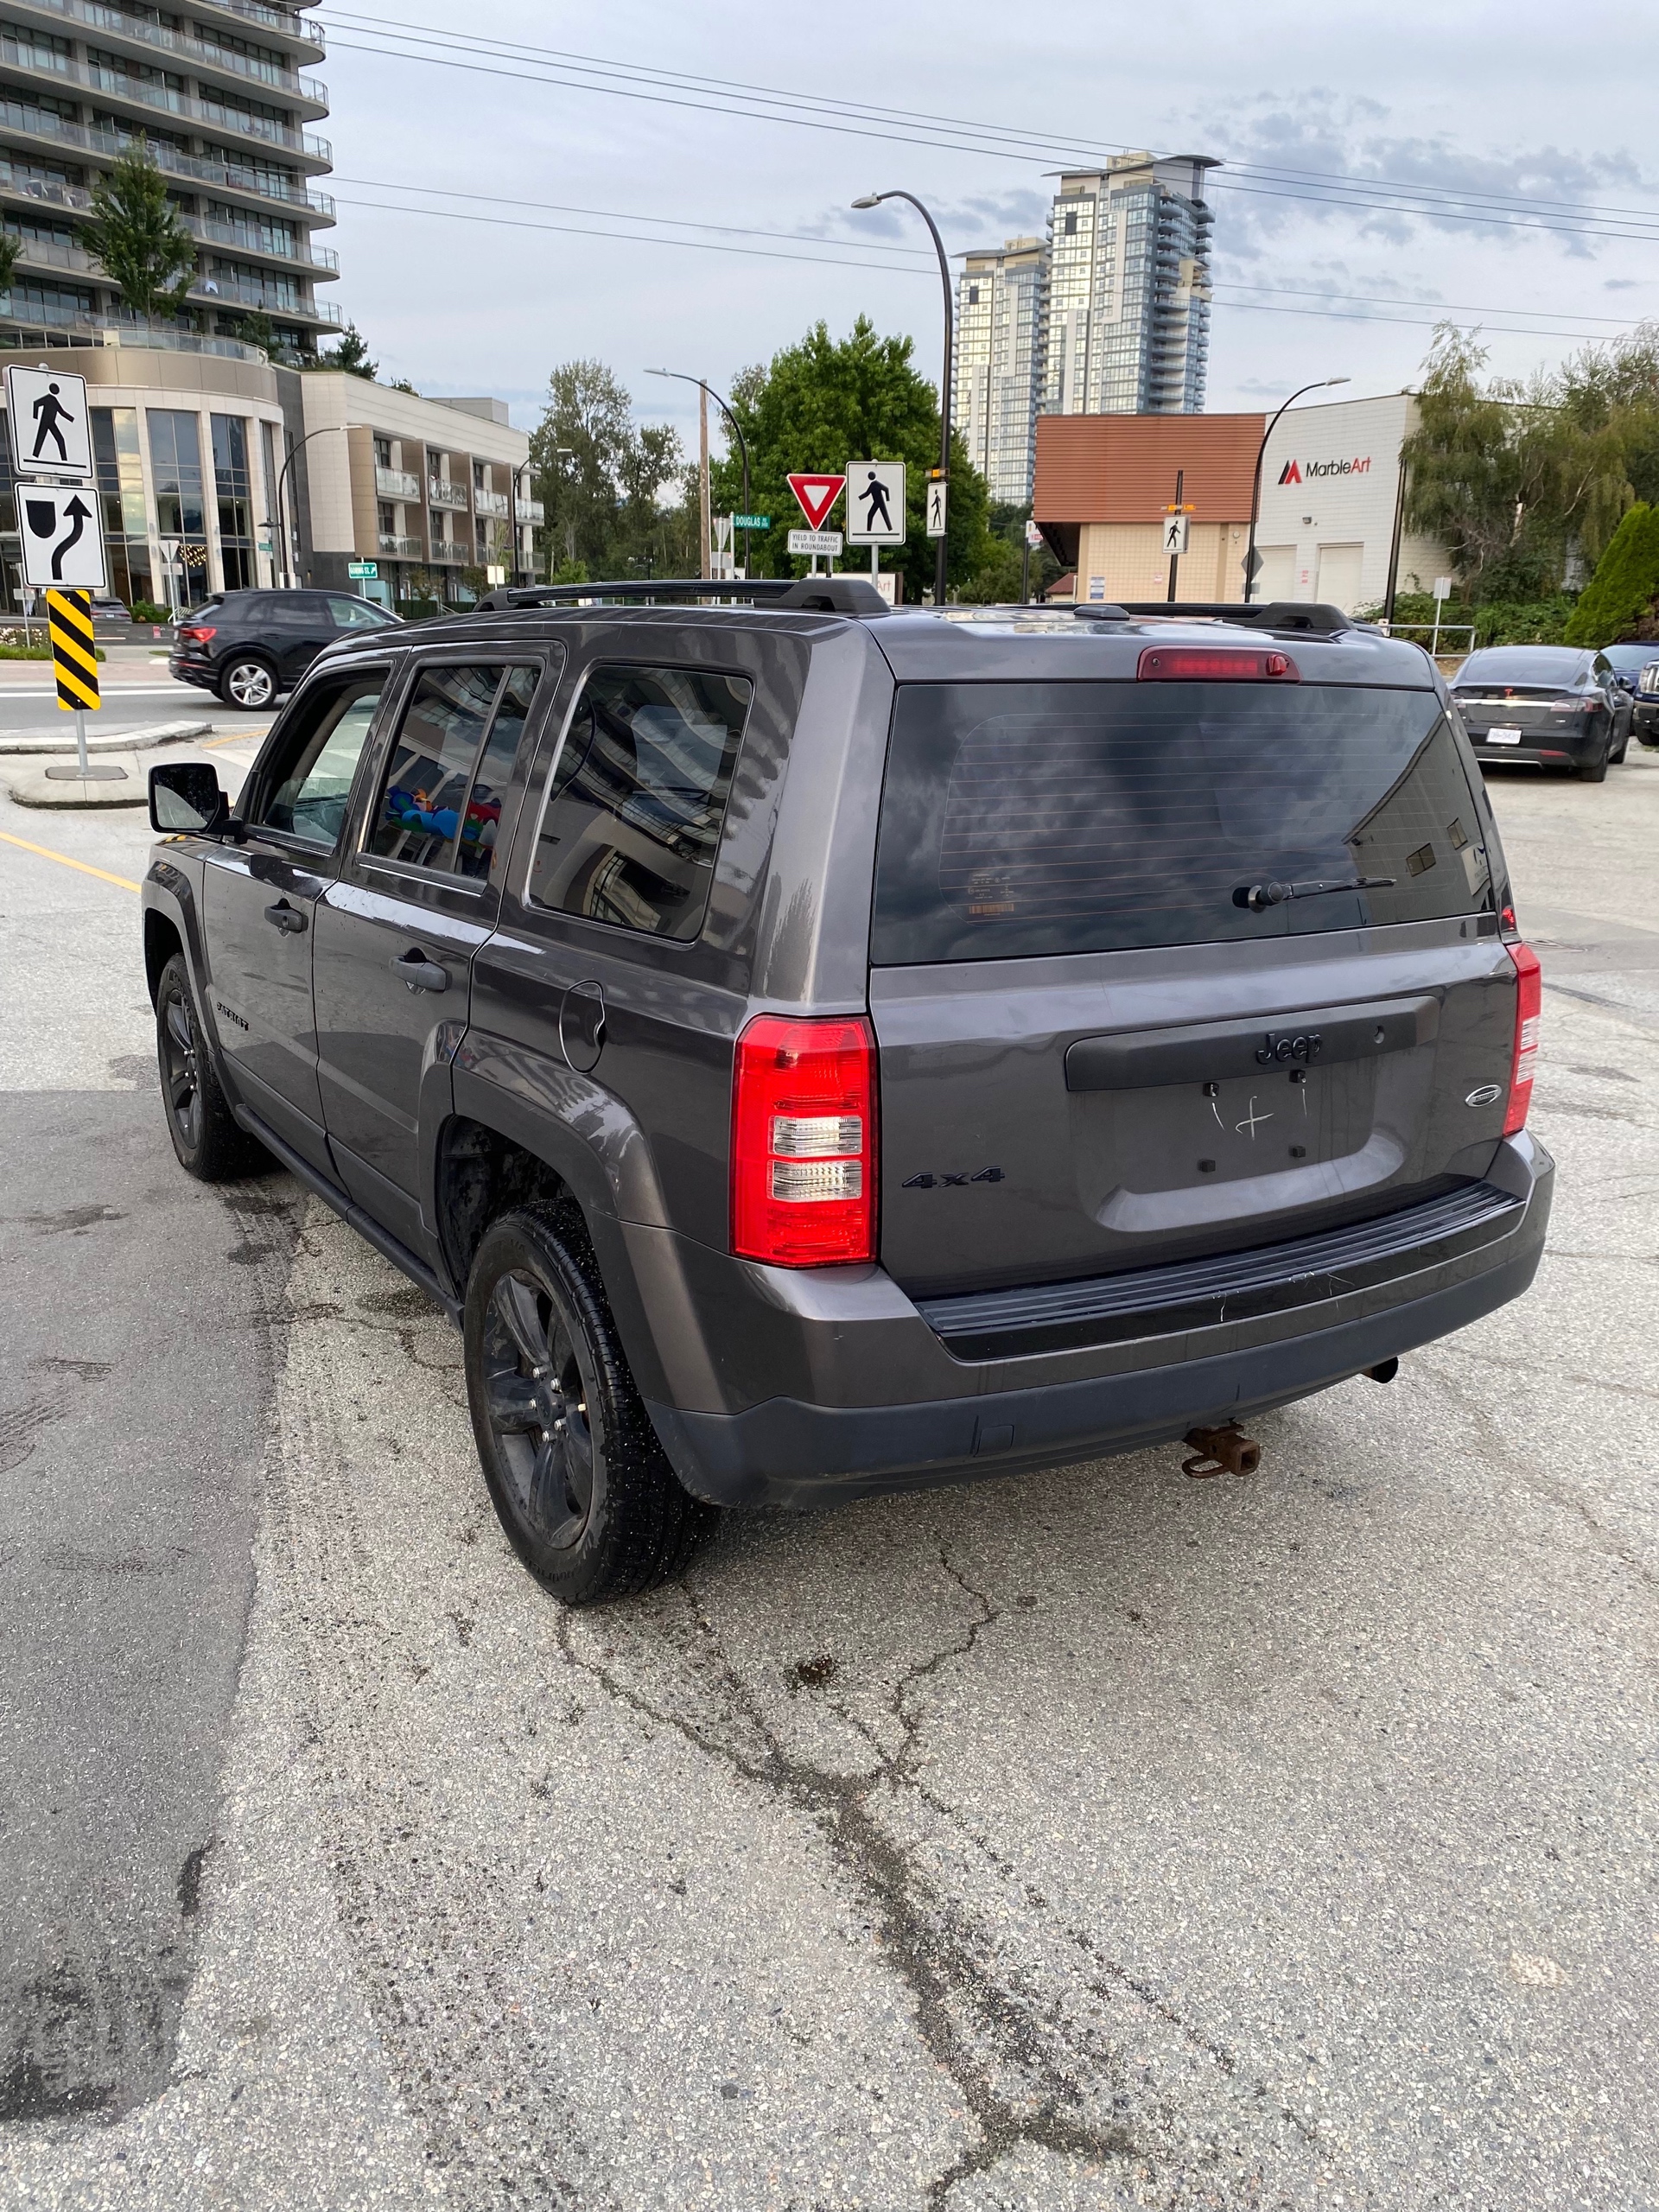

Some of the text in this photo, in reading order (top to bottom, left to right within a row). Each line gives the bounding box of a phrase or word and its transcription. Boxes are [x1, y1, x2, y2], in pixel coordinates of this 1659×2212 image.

[1306, 456, 1371, 477] MarbleArt
[735, 516, 760, 526] DOUGLAS
[217, 1001, 249, 1031] PATRIOT
[1255, 1033, 1323, 1065] Jeep
